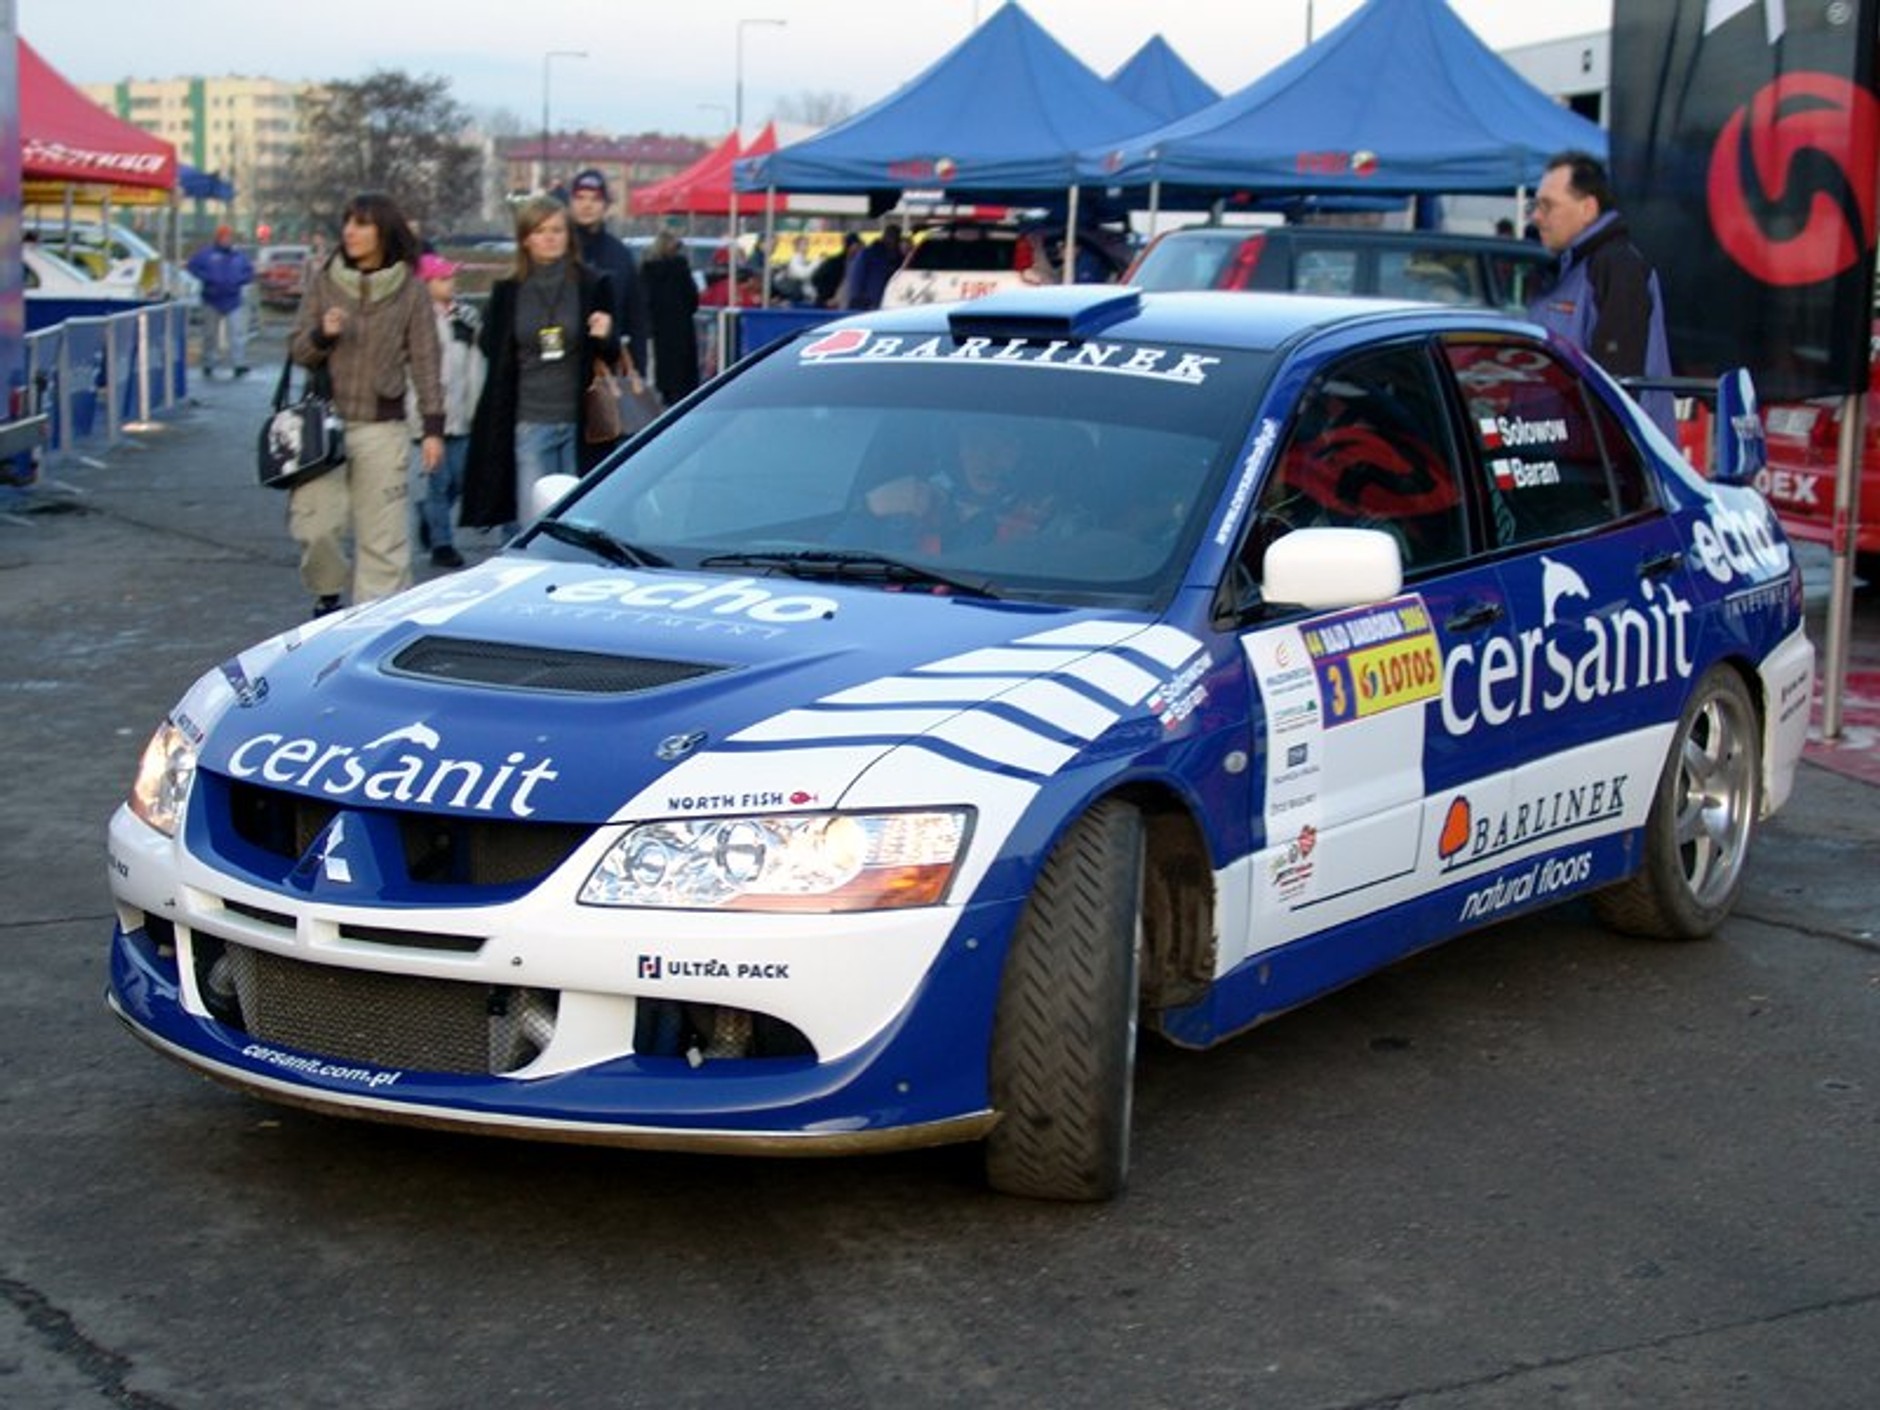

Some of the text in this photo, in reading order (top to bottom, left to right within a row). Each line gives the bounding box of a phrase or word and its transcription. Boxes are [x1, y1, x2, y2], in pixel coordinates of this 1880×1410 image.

[859, 336, 1221, 380] BARLINEK
[1509, 457, 1561, 488] Baran
[548, 576, 839, 623] echo
[1441, 577, 1693, 736] cersanit
[1327, 647, 1437, 717] 3 LOTOS
[227, 733, 558, 817] cersanit
[667, 792, 784, 810] NORTH FISH
[1471, 774, 1628, 856] BARLINEK
[1458, 851, 1592, 922] natural floors
[667, 959, 790, 979] ULTRA PACK
[242, 1044, 402, 1088] cersanit.com.pl
